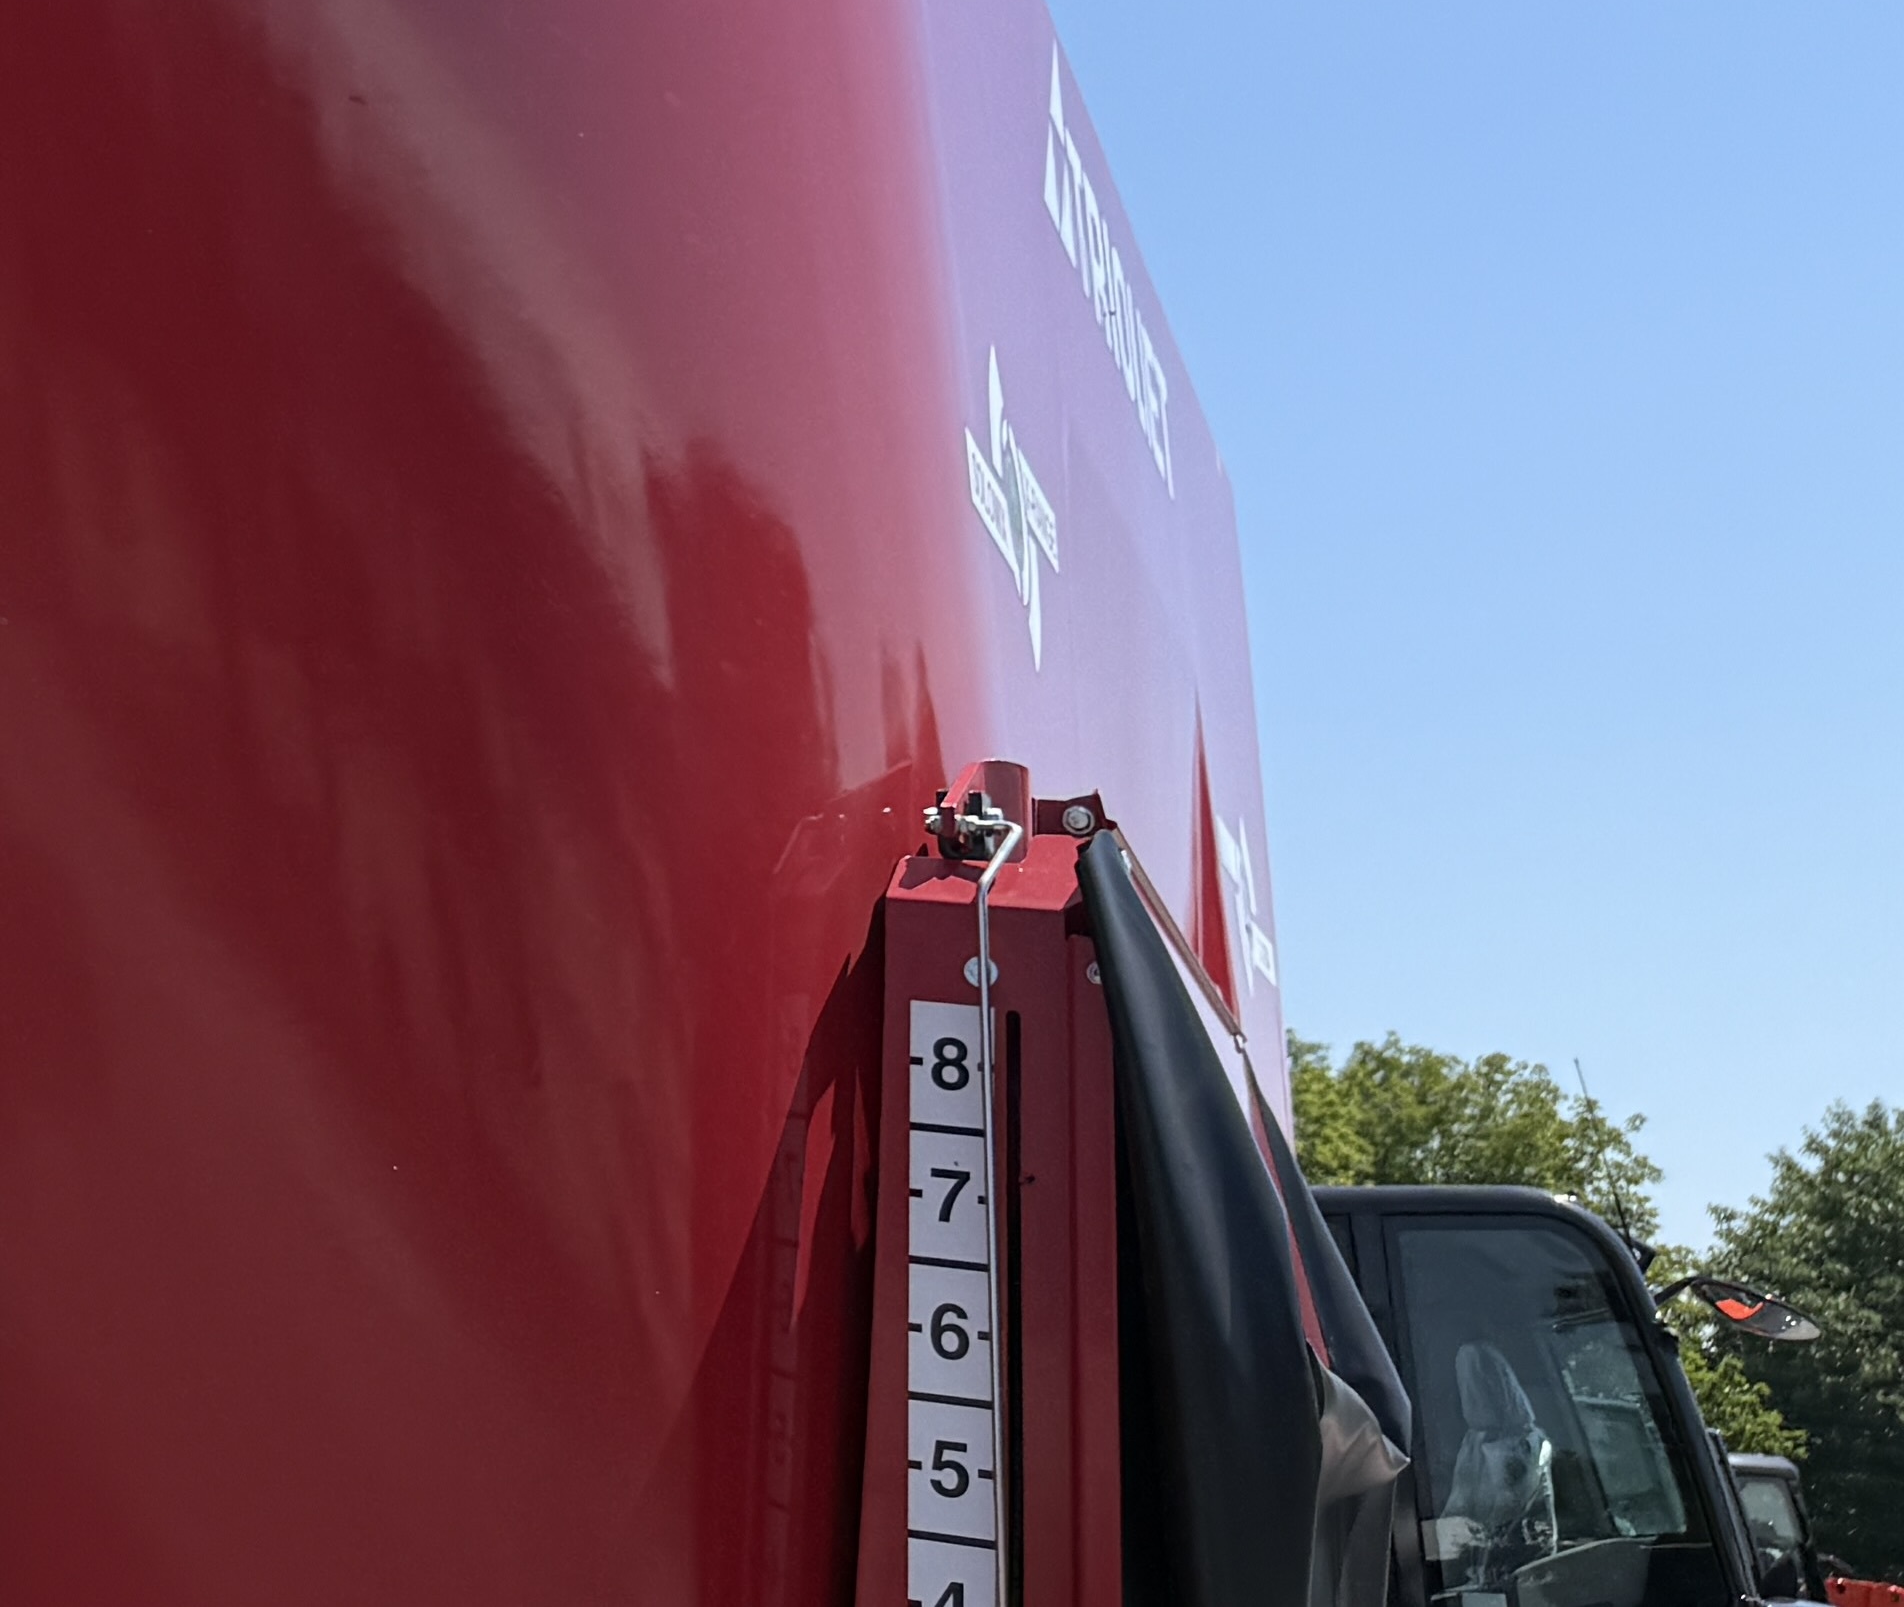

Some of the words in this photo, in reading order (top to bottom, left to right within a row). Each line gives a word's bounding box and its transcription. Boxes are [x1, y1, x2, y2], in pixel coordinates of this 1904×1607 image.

[930, 1036, 970, 1092] 8
[930, 1167, 971, 1223] 7
[929, 1302, 970, 1360] 6
[929, 1439, 970, 1498] 5
